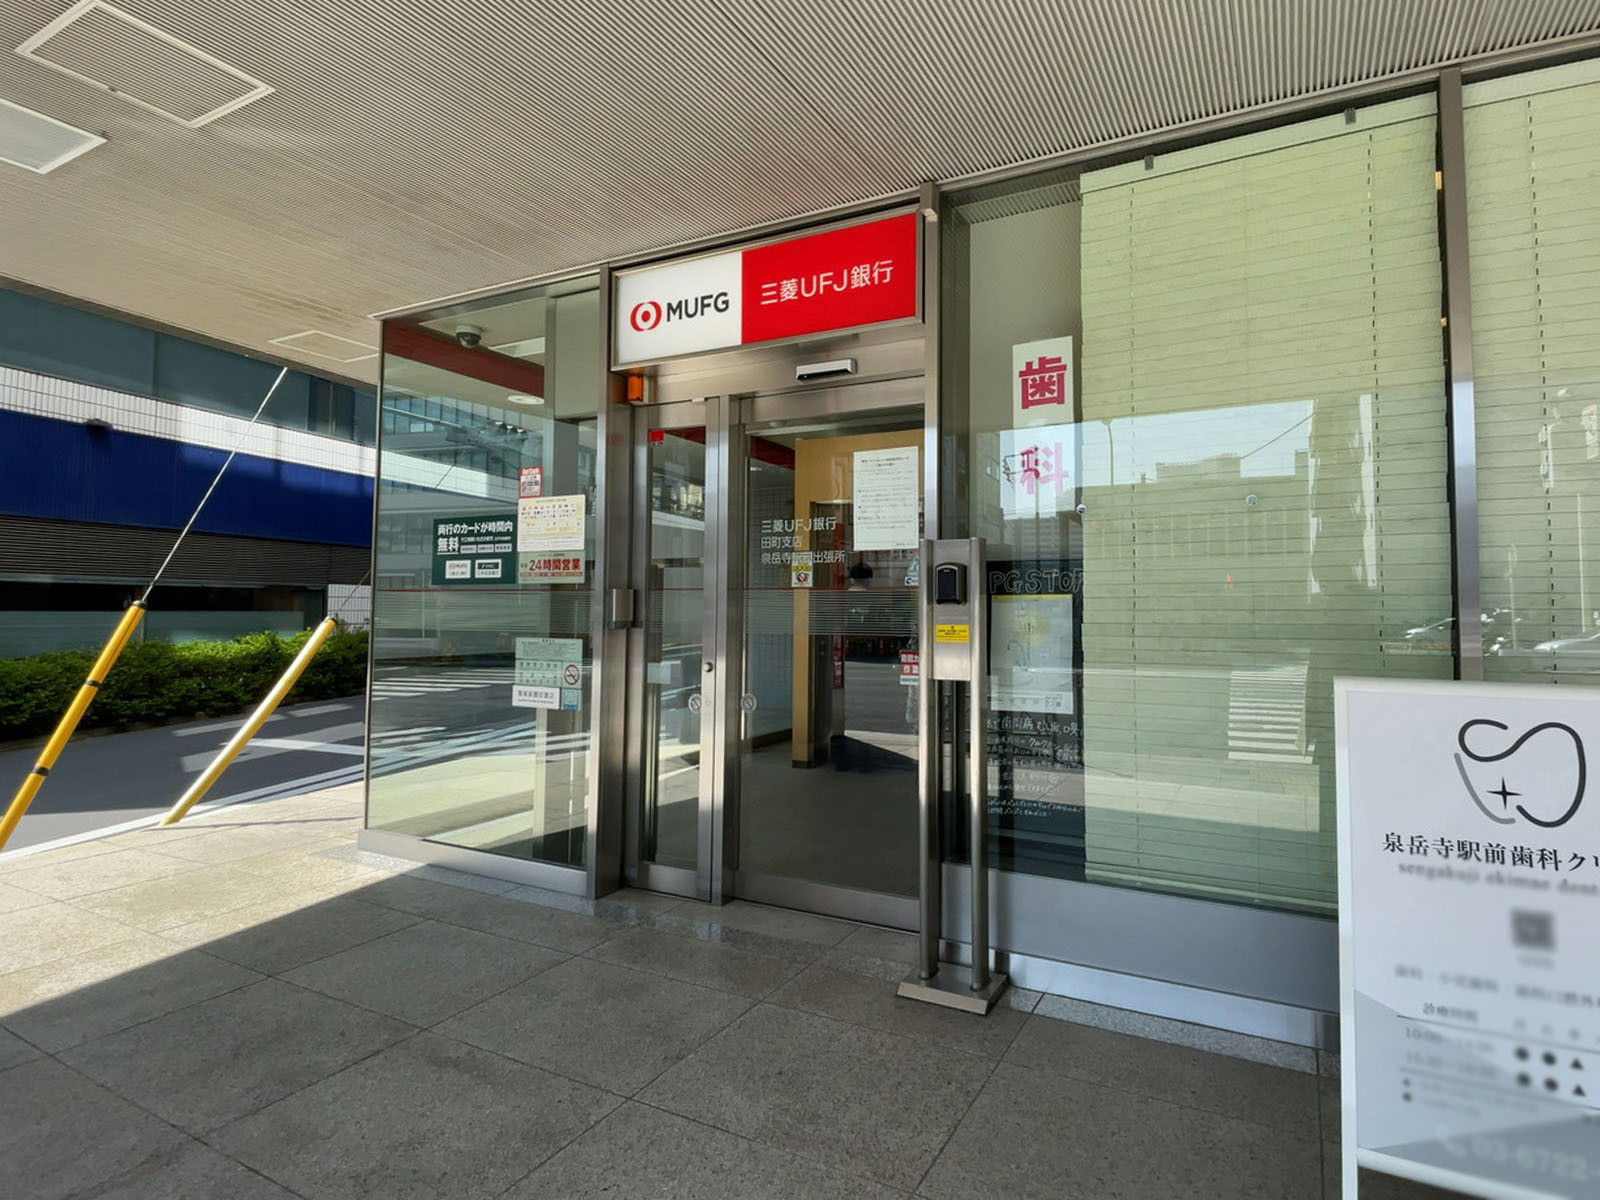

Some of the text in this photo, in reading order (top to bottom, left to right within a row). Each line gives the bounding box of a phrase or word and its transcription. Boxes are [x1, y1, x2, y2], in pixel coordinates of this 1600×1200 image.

[760, 259, 894, 305] 三菱UFJ銀行
[666, 292, 730, 322] MUFG
[1018, 356, 1069, 495] 歯科
[437, 520, 513, 536] 両行のカードが時間内
[761, 517, 836, 533] 三菱UFJ銀行
[437, 536, 459, 553] 無料
[761, 536, 803, 549] 田町支店
[528, 558, 581, 572] 24時間営業
